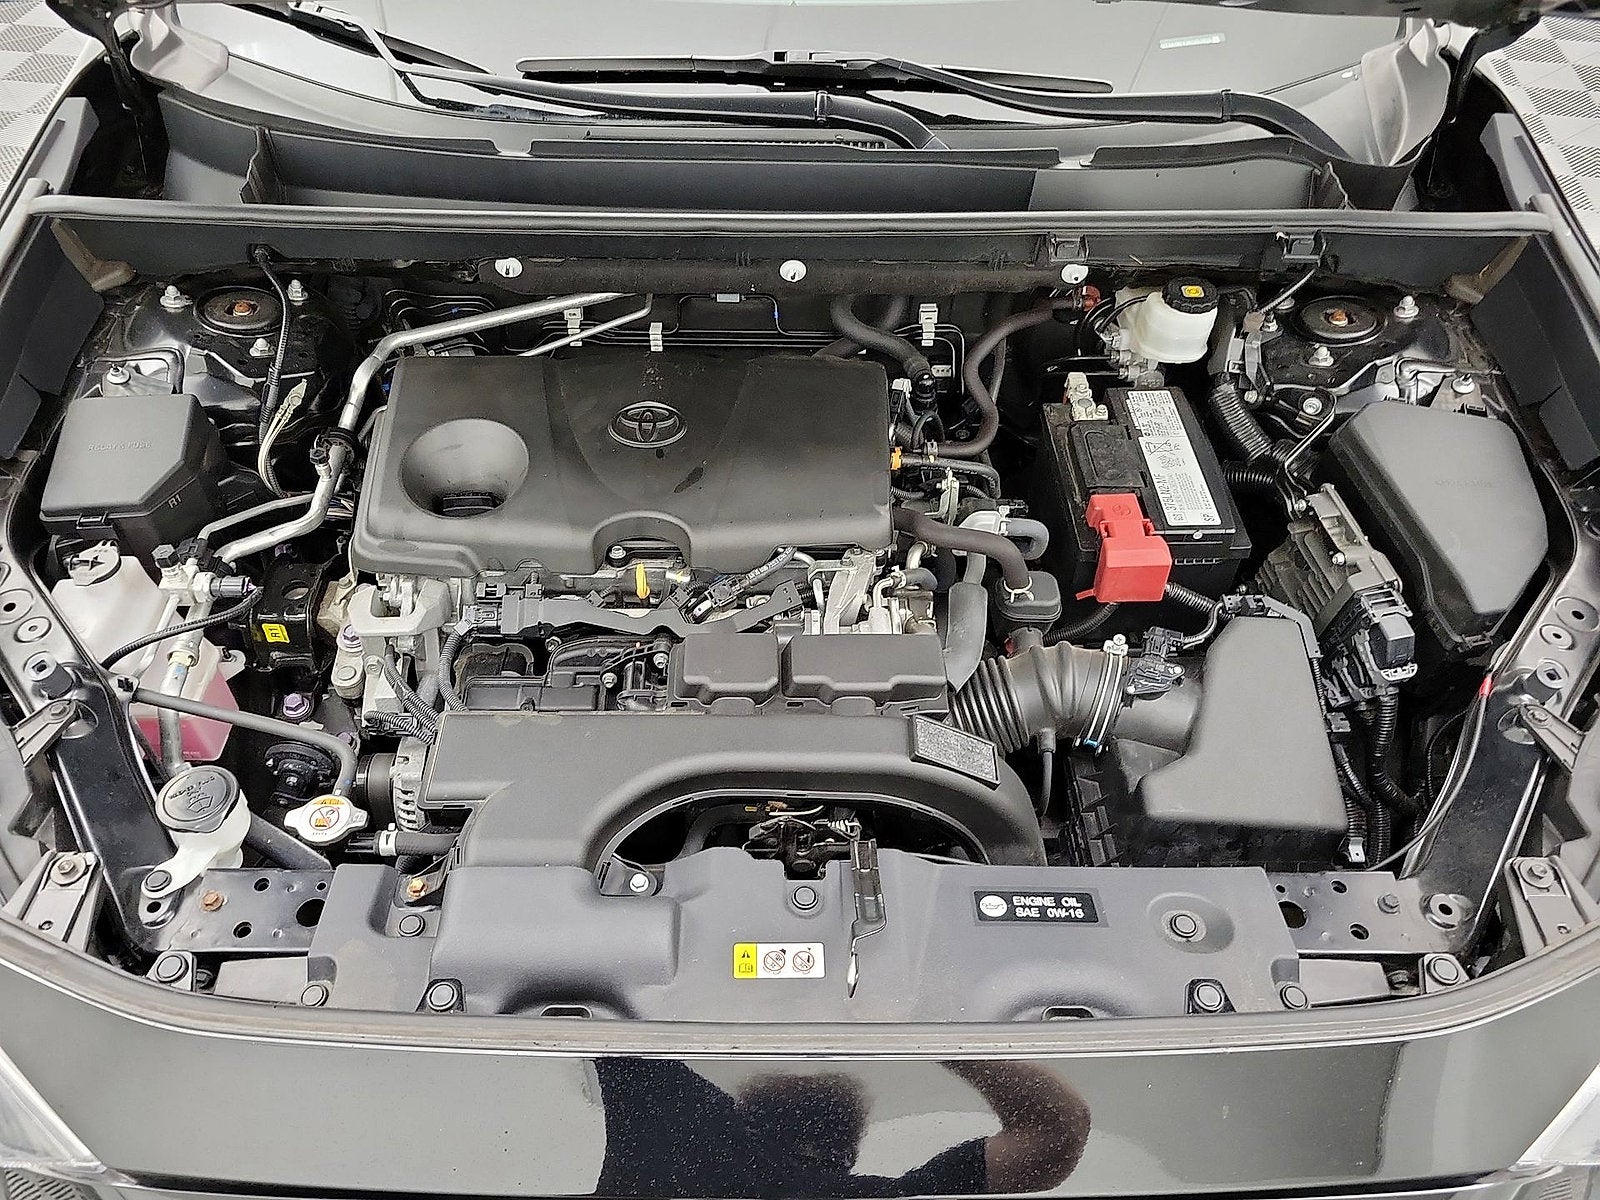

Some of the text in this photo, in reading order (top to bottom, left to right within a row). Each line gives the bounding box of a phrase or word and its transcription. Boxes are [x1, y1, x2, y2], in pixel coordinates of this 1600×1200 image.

[168, 494, 181, 508] R1
[1012, 895, 1082, 908] ENGINE OIL
[1015, 908, 1085, 919] SAE 0W-16
